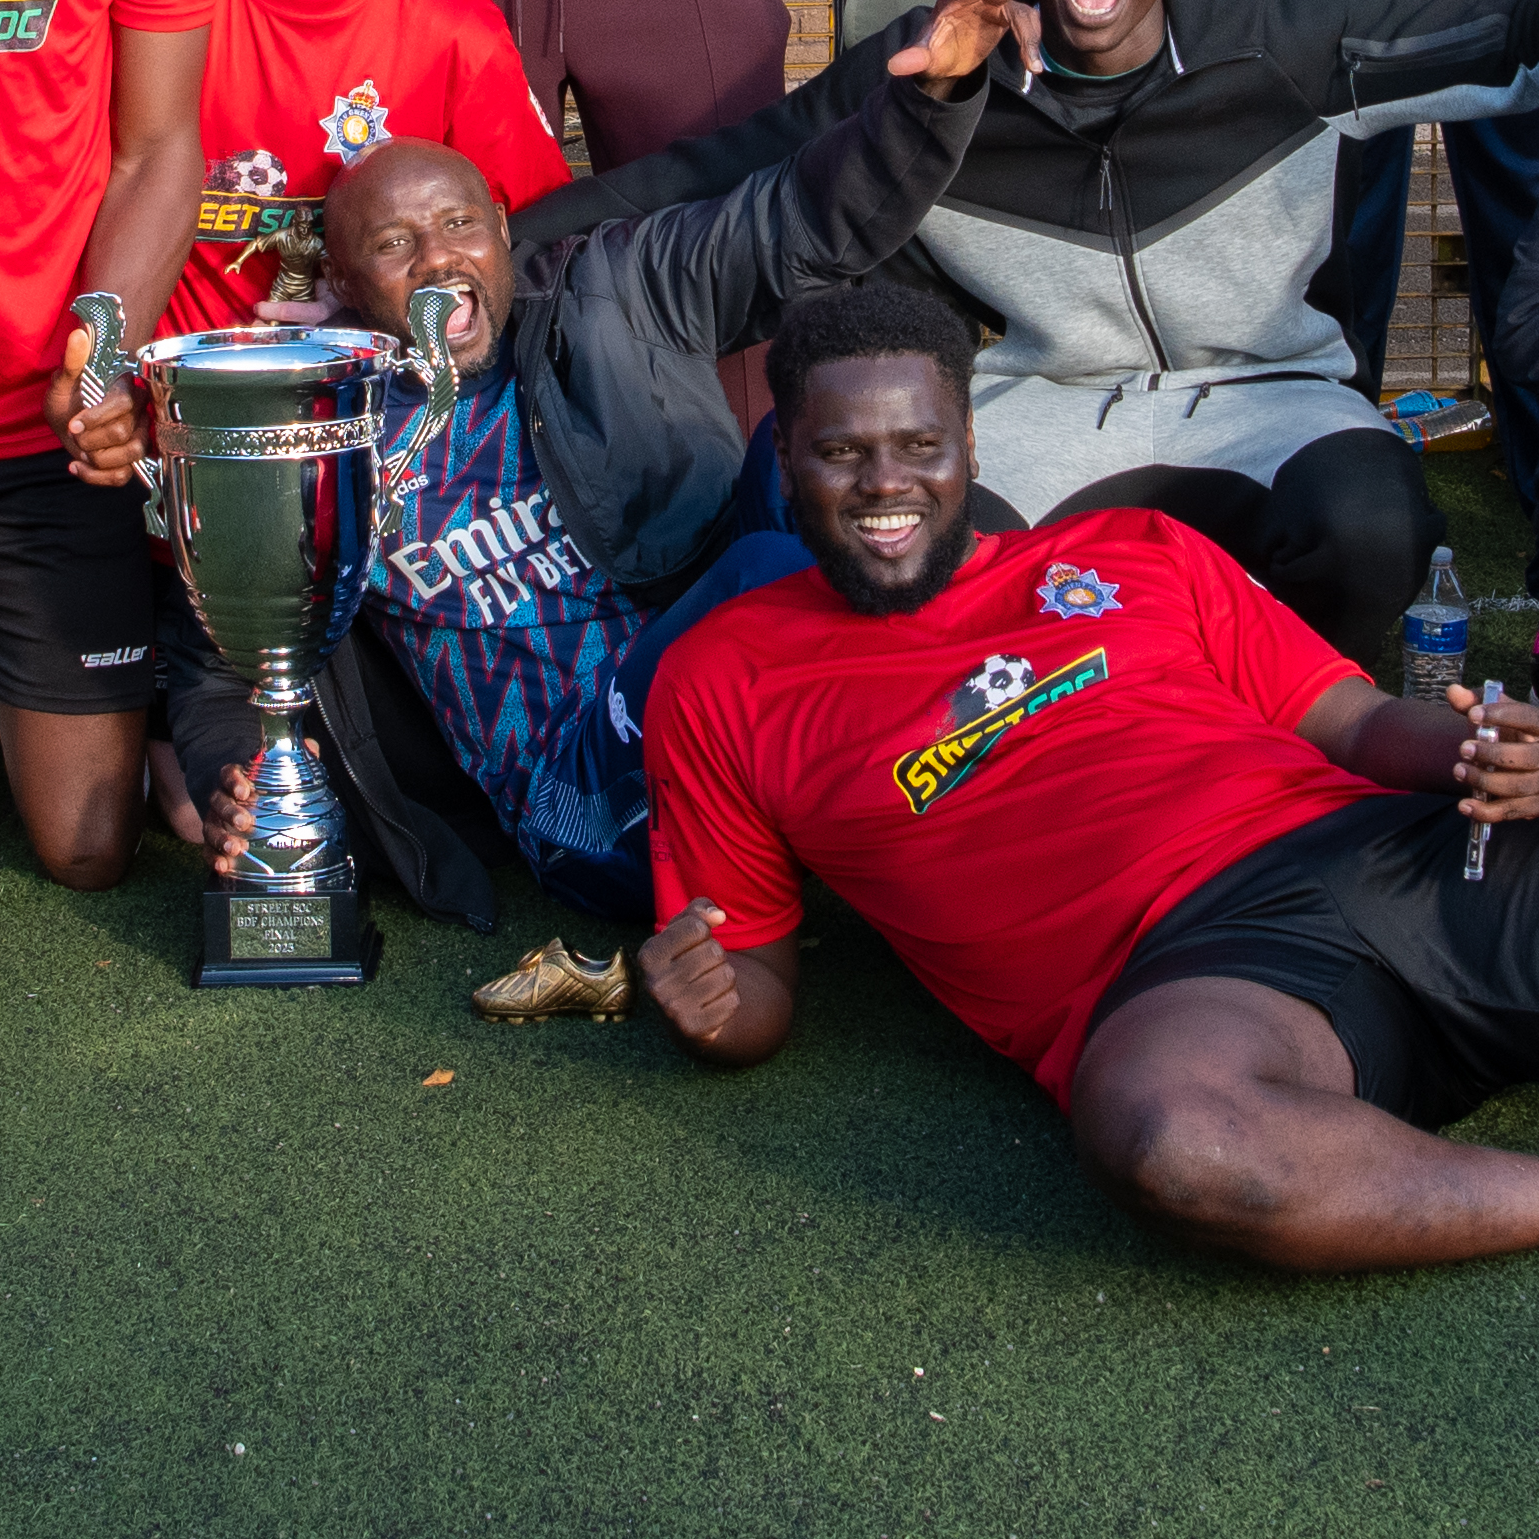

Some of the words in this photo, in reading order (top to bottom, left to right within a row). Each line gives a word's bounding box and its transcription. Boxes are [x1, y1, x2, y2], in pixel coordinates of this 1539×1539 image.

[395, 474, 430, 496] das
[468, 562, 531, 625] FLY
[527, 534, 593, 590] BET
[247, 903, 290, 914] STREET
[292, 903, 313, 914] SOC
[237, 916, 258, 928] BDF
[261, 915, 325, 928] CHAMPIONS
[264, 929, 297, 941] FINAL
